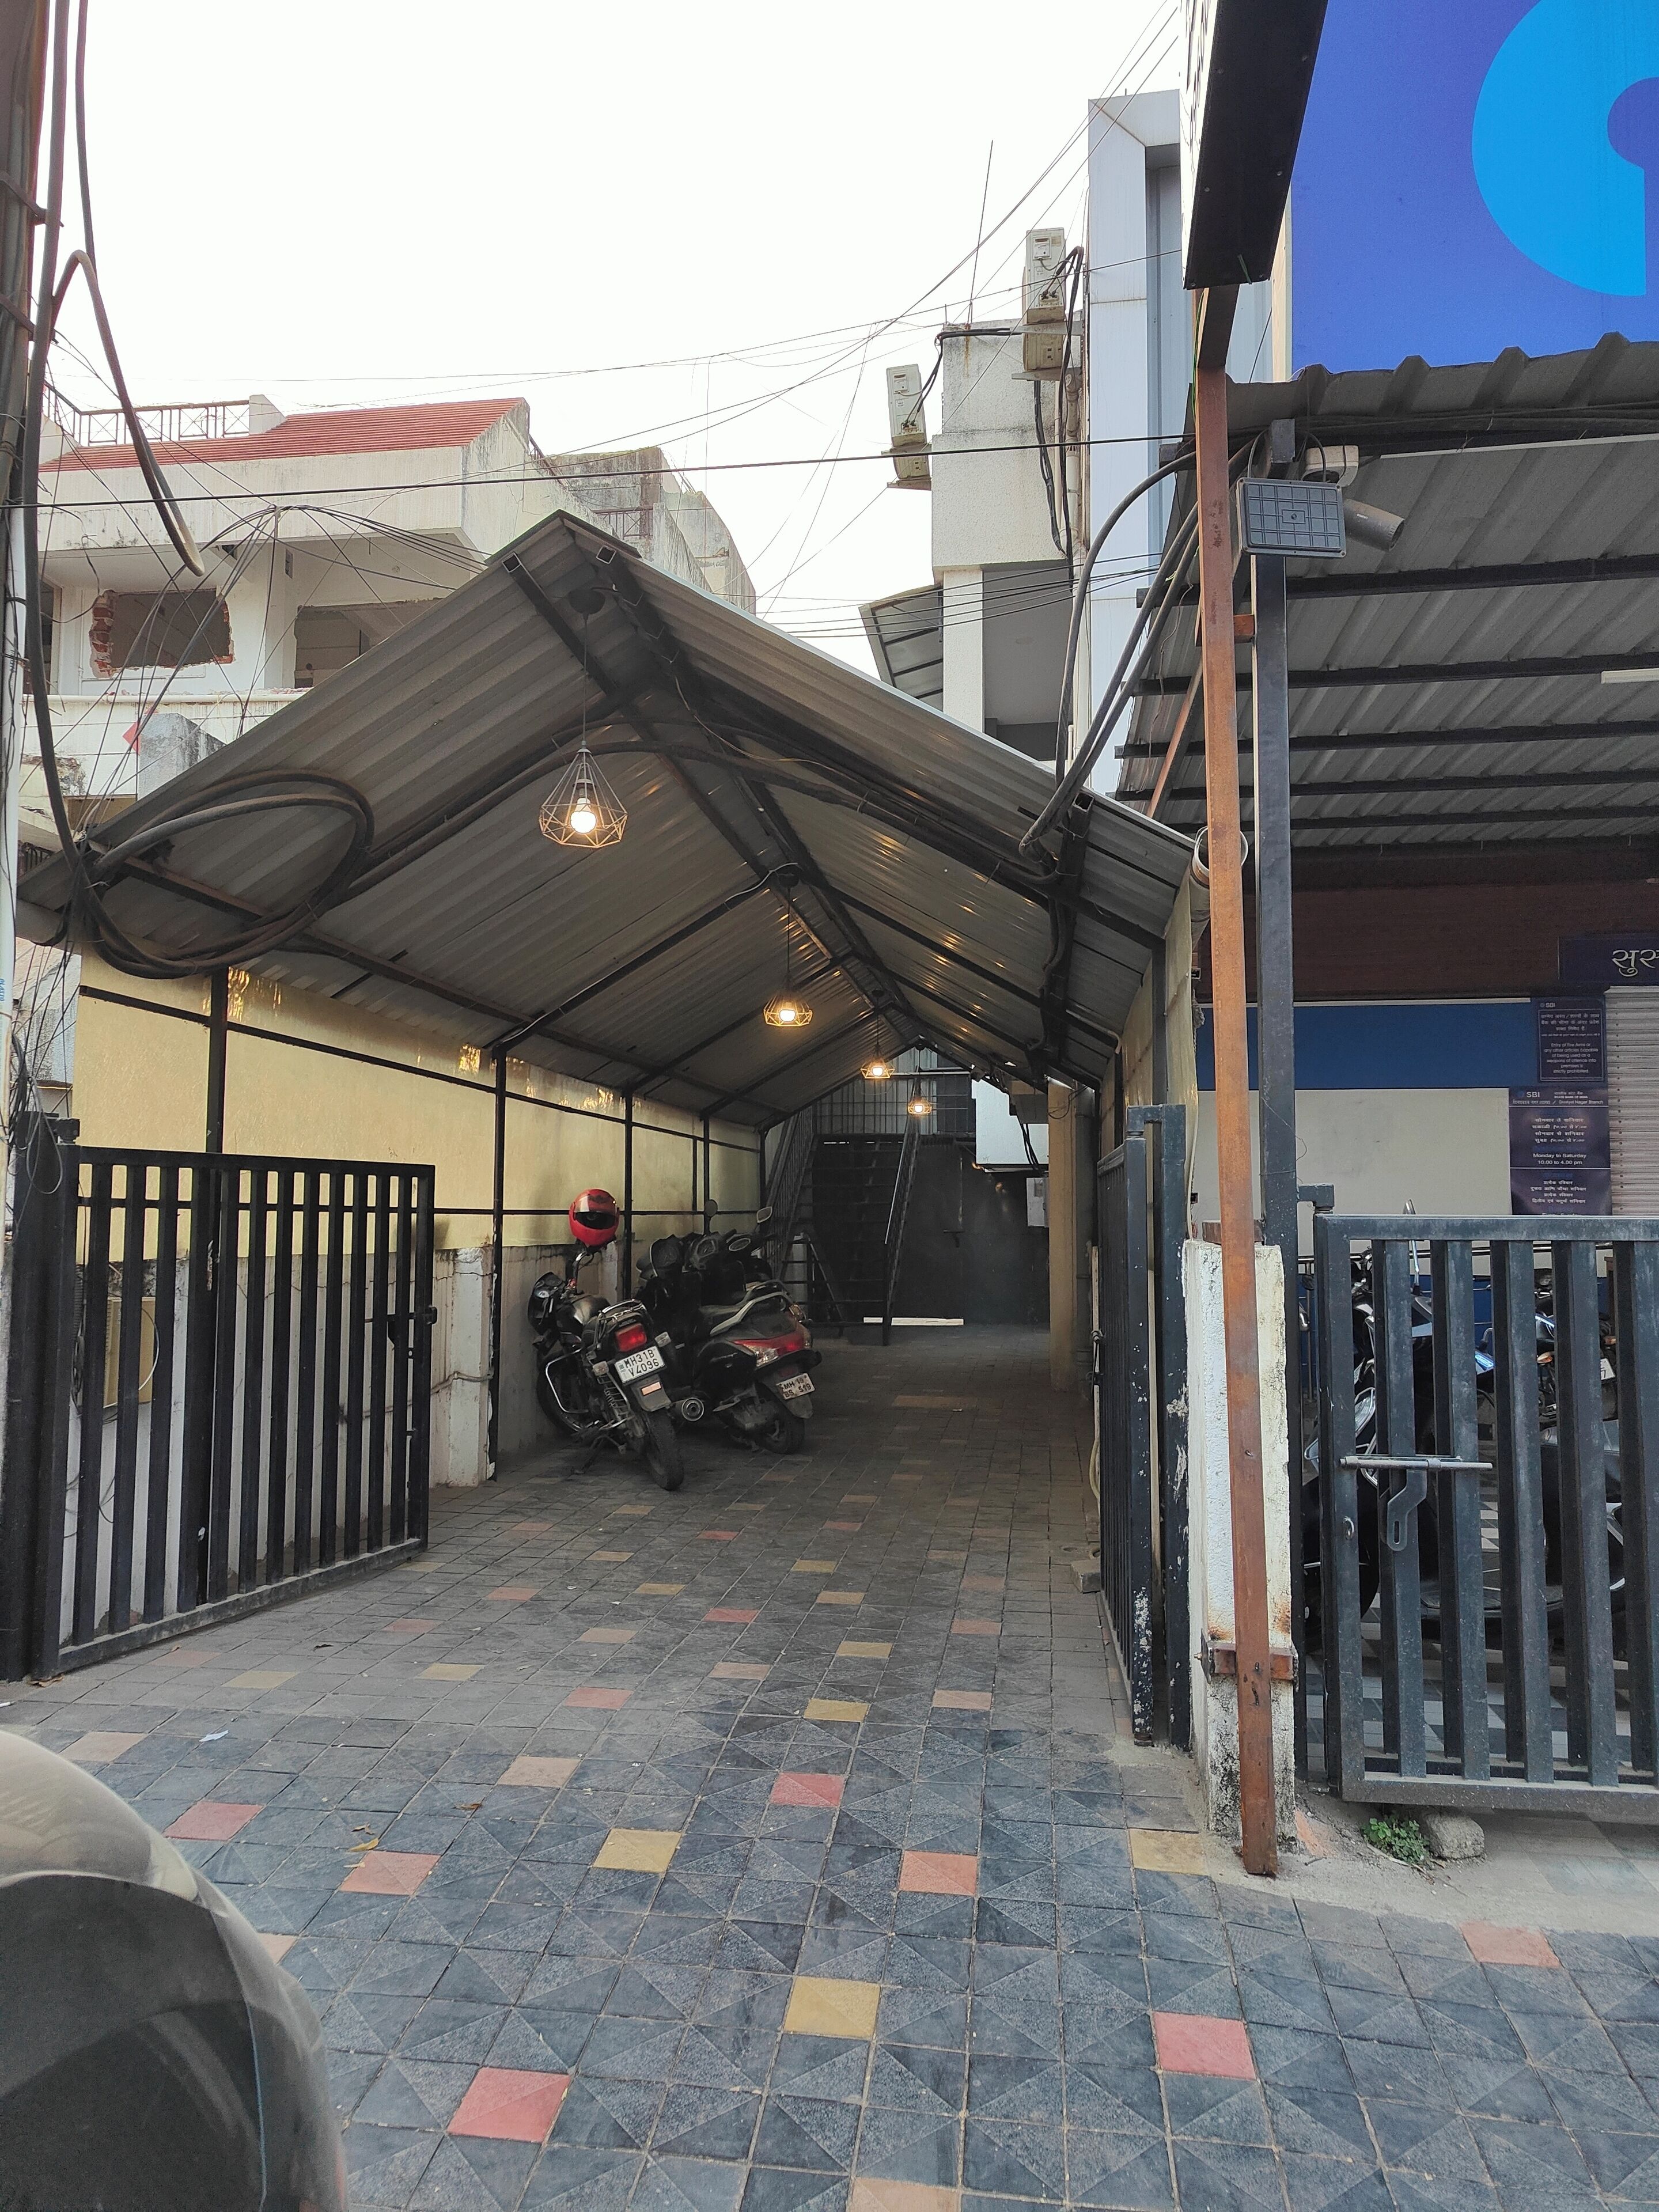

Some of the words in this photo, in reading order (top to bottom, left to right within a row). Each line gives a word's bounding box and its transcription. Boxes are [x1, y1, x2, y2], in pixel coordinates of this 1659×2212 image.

[624, 1350, 654, 1368] MH31B
[628, 1359, 659, 1377] V4096
[784, 1381, 795, 1389] MH
